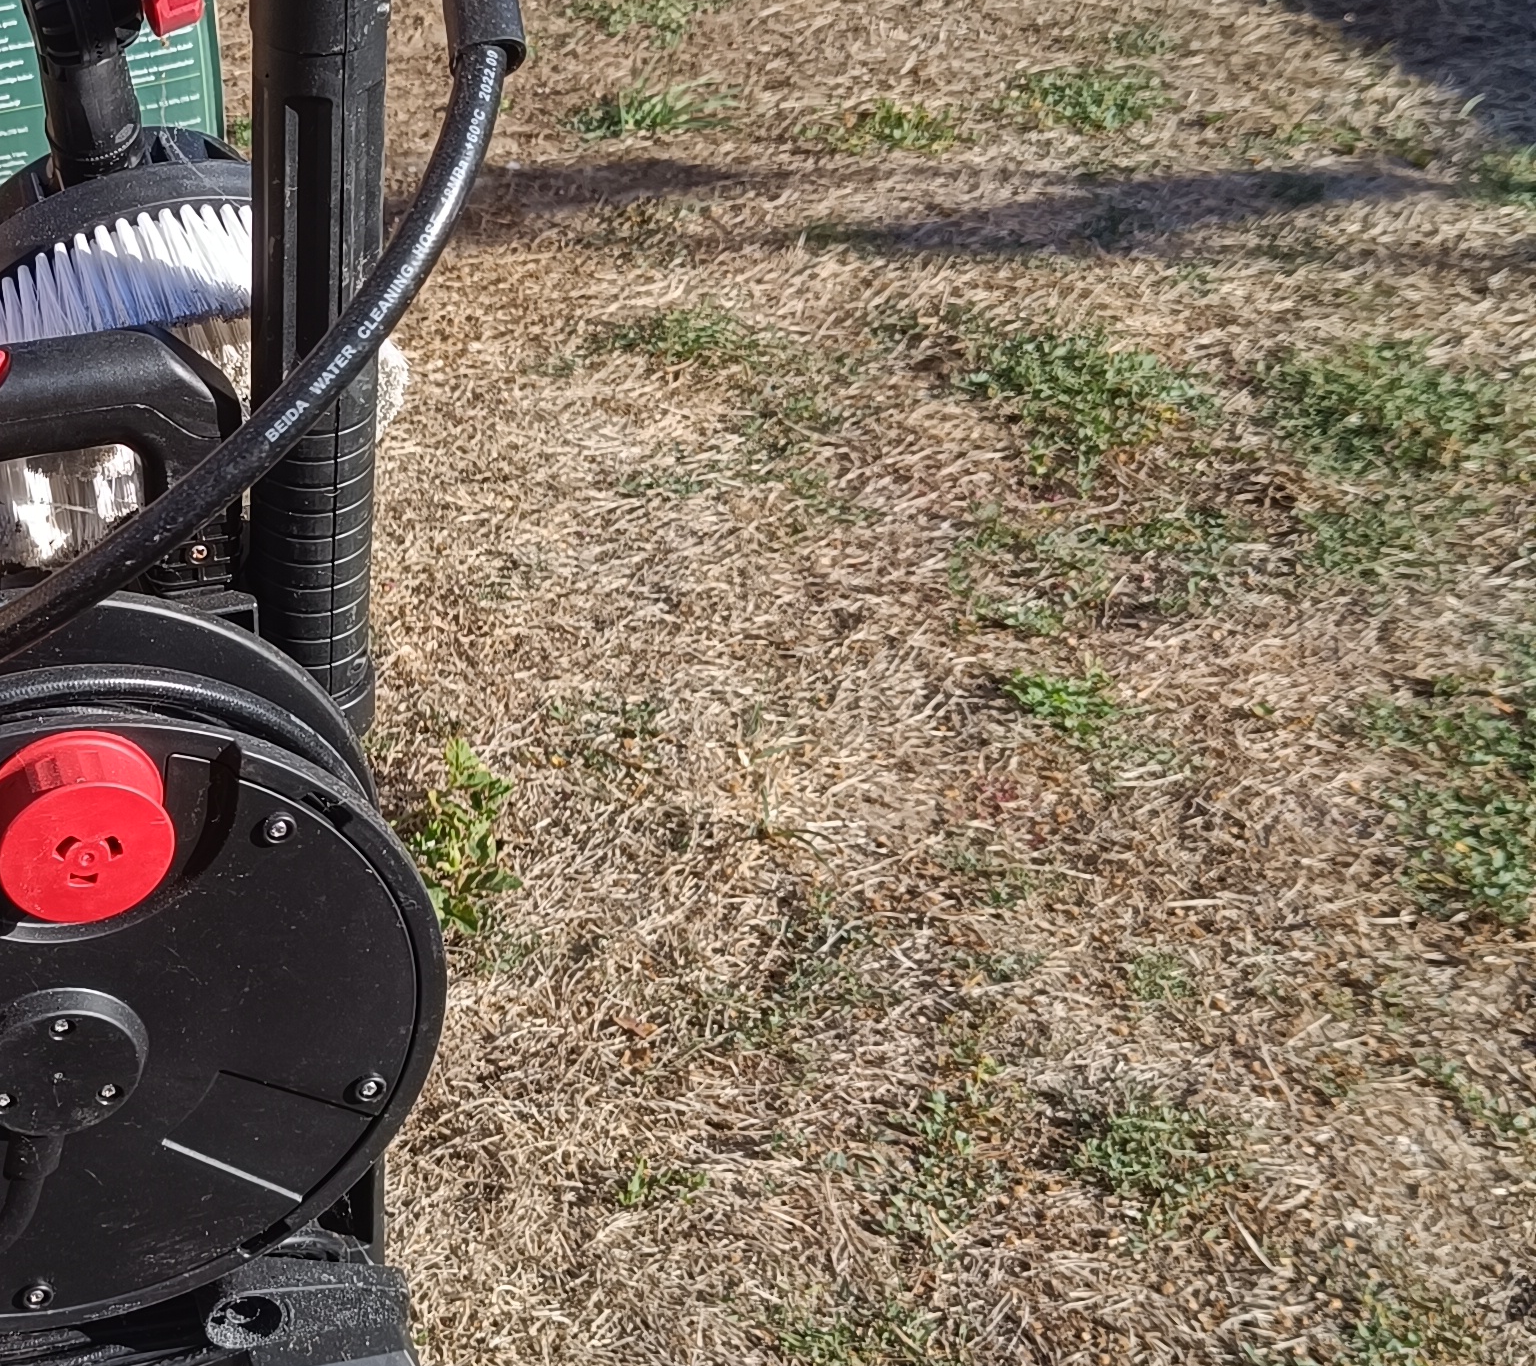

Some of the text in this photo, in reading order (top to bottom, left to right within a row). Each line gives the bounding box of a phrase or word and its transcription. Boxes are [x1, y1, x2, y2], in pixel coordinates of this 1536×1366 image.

[264, 399, 311, 443] BEIDA
[308, 344, 358, 395] WATER
[357, 263, 414, 339] CLEANING
[412, 212, 441, 255] HOSE
[478, 49, 499, 102] 2022.09
